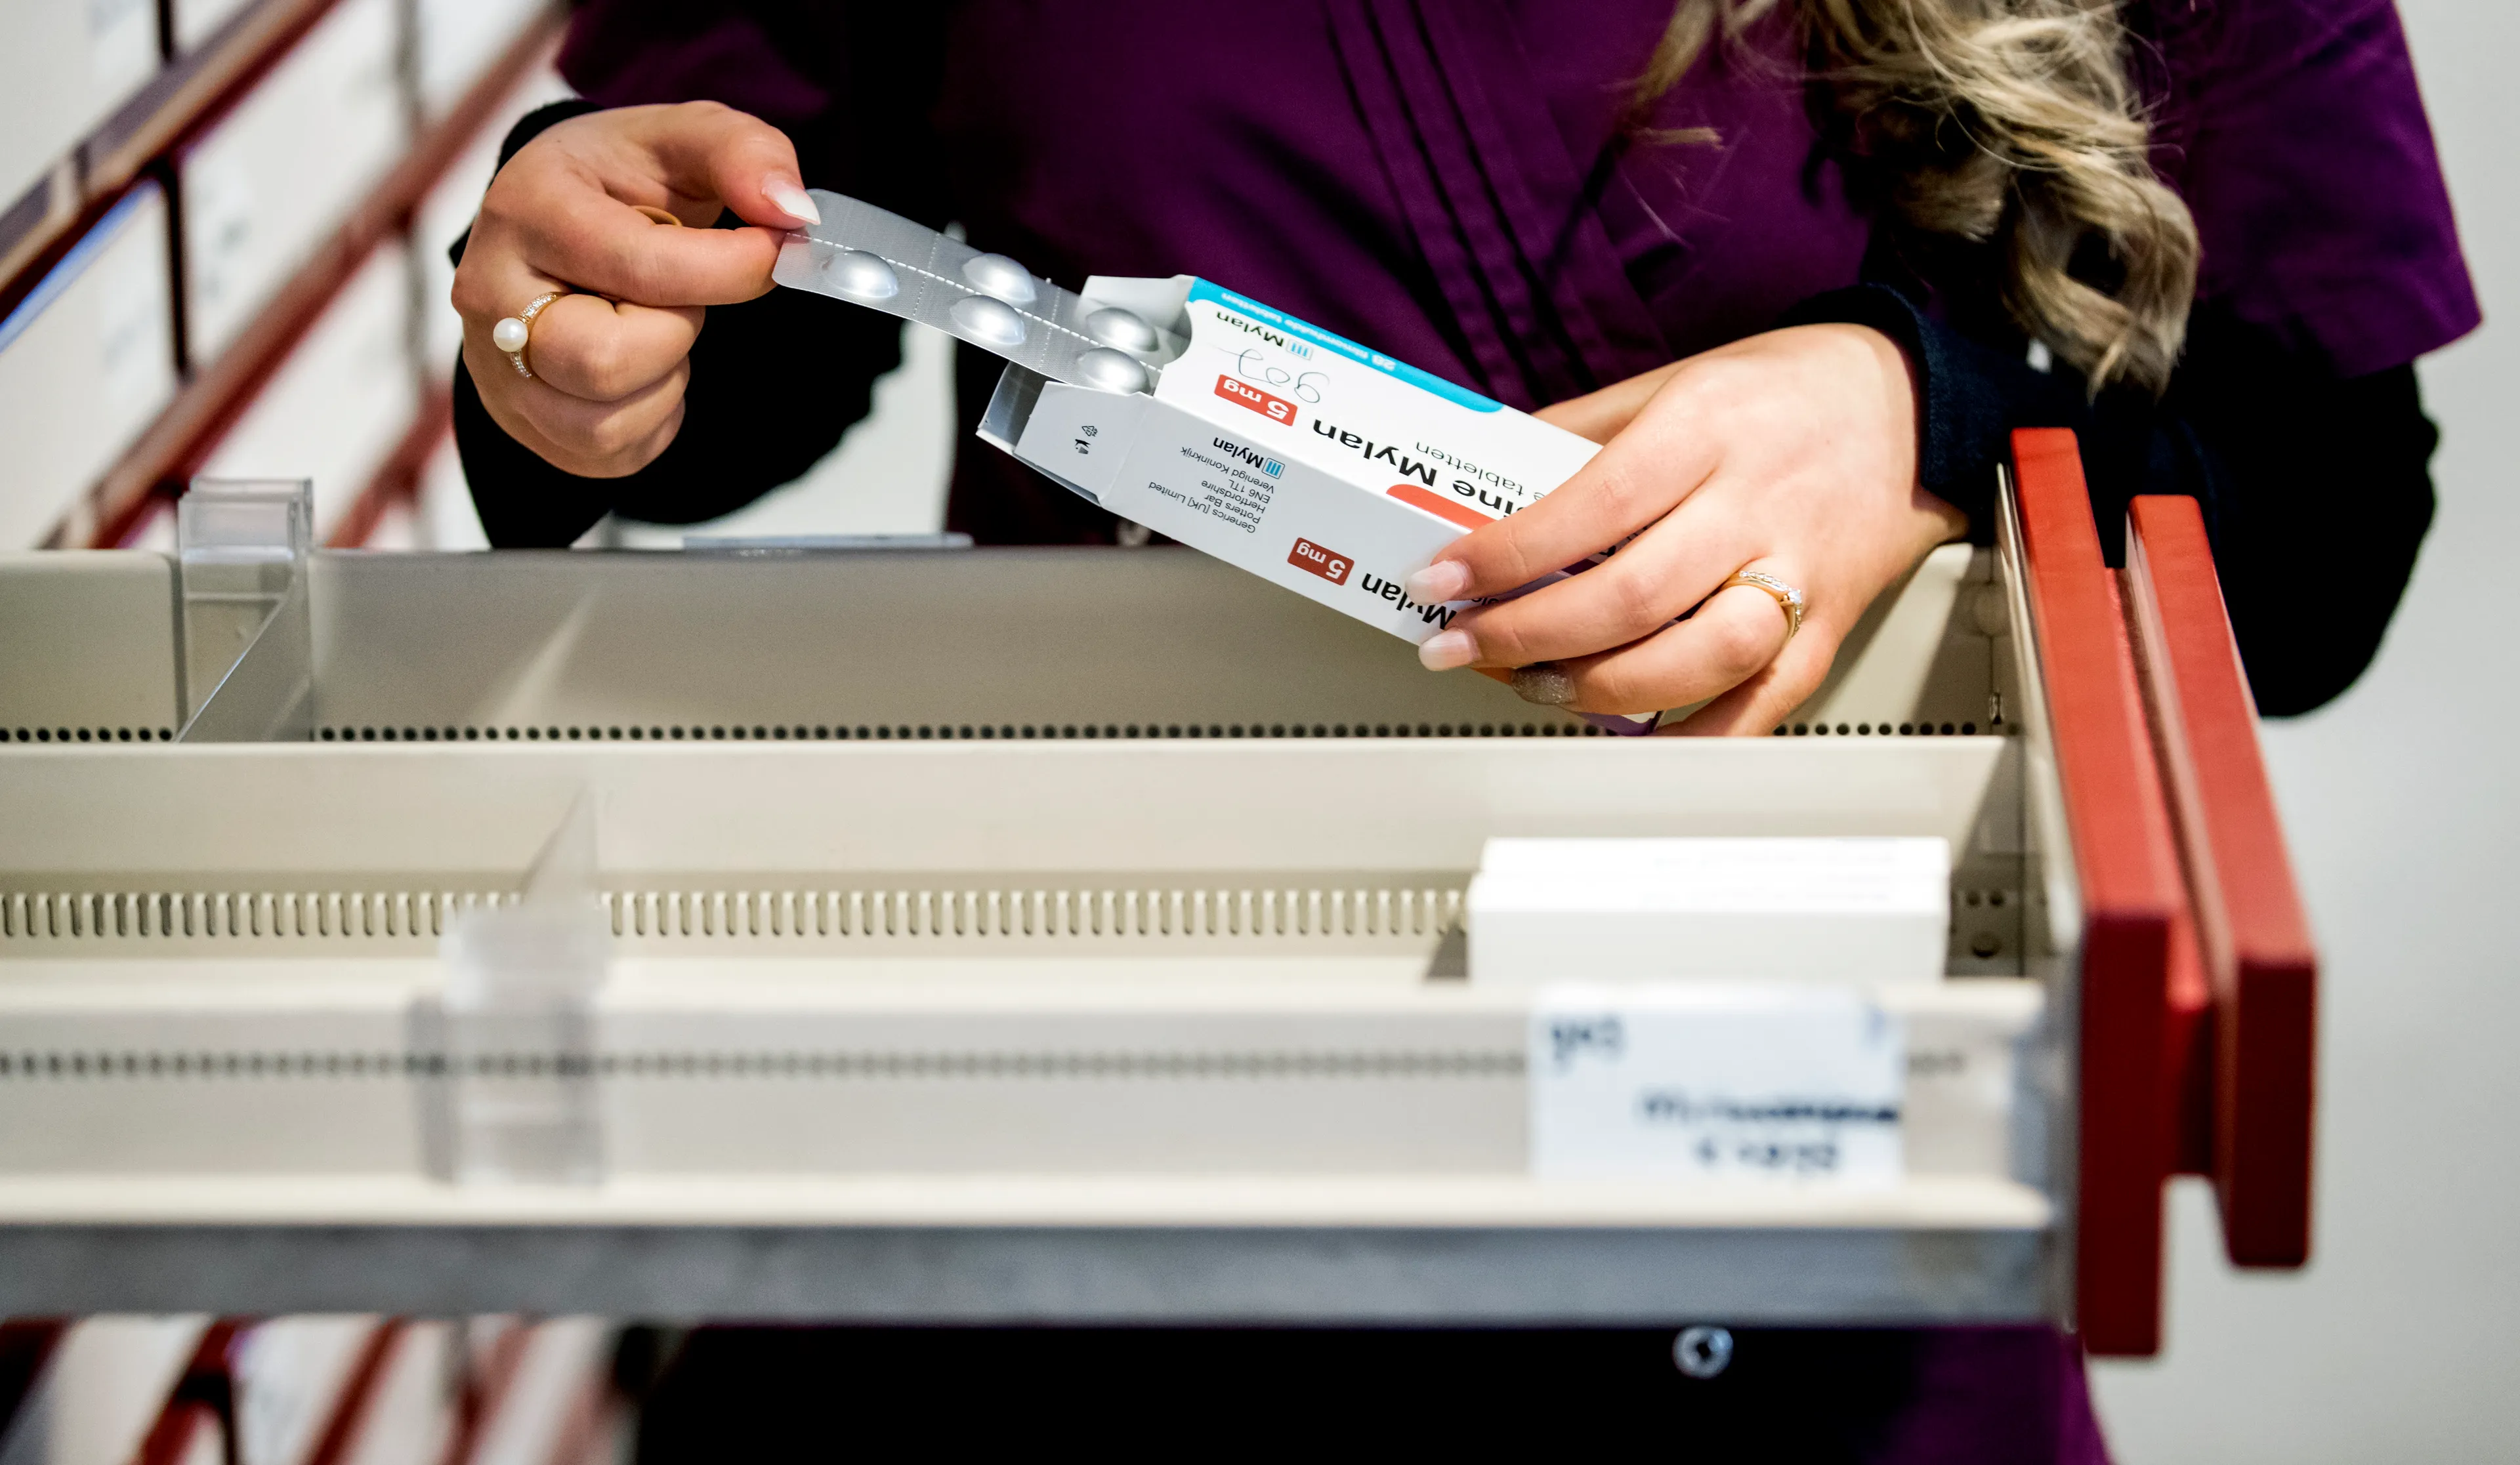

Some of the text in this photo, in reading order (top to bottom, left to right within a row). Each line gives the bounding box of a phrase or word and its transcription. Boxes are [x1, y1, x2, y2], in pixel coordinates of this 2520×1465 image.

[1217, 311, 1284, 347] Mylan
[1372, 352, 1396, 371] 28
[1213, 437, 1264, 468] Mylan
[1223, 379, 1526, 518] ine Mylan 5 mg
[1180, 446, 1274, 493] Verenigd Koninkrijk
[1416, 442, 1524, 495] tabletten
[1148, 482, 1256, 533] Generics [UK] Limited
[1201, 480, 1266, 514] Hertfordshire
[1228, 479, 1270, 504] EN6 1TL
[1204, 495, 1261, 524] Potters Bar
[1297, 542, 1326, 564] mg
[1326, 559, 1346, 579] 5
